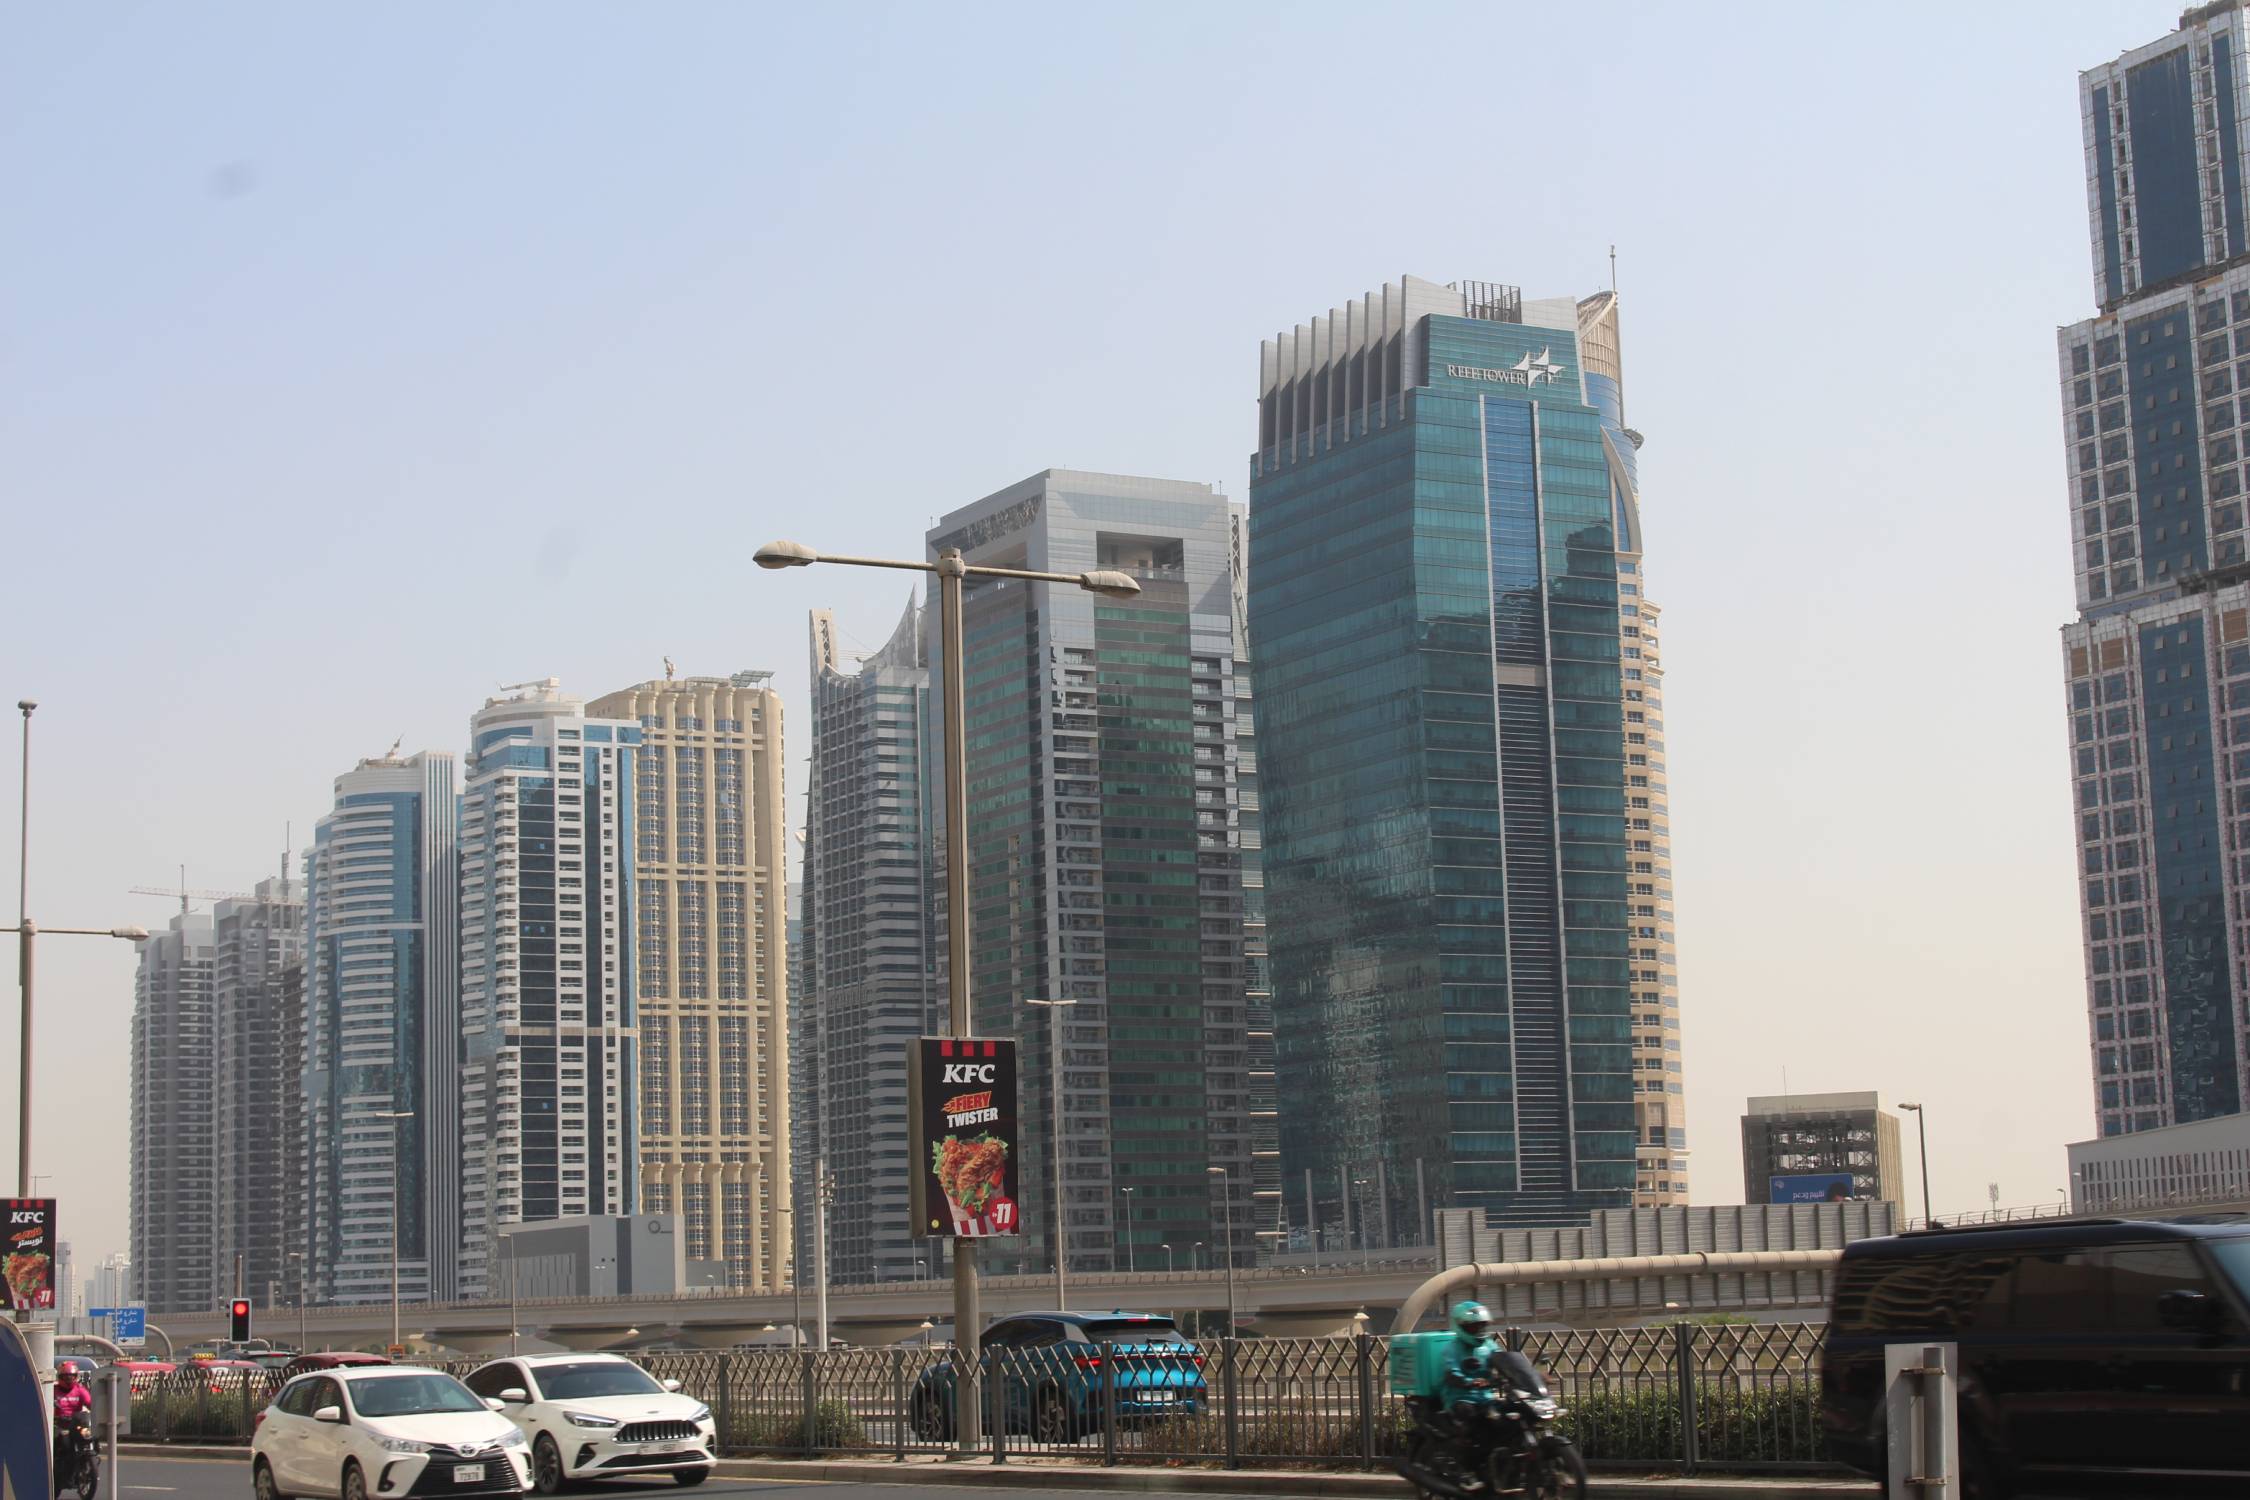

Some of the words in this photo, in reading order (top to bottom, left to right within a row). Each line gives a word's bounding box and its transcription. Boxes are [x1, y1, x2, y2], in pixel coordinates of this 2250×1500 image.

[942, 1063, 996, 1084] KFC
[954, 1092, 991, 1113] FIERY
[946, 1107, 999, 1129] TWISTER
[10, 1211, 45, 1224] KFC
[996, 1203, 1012, 1224] 11
